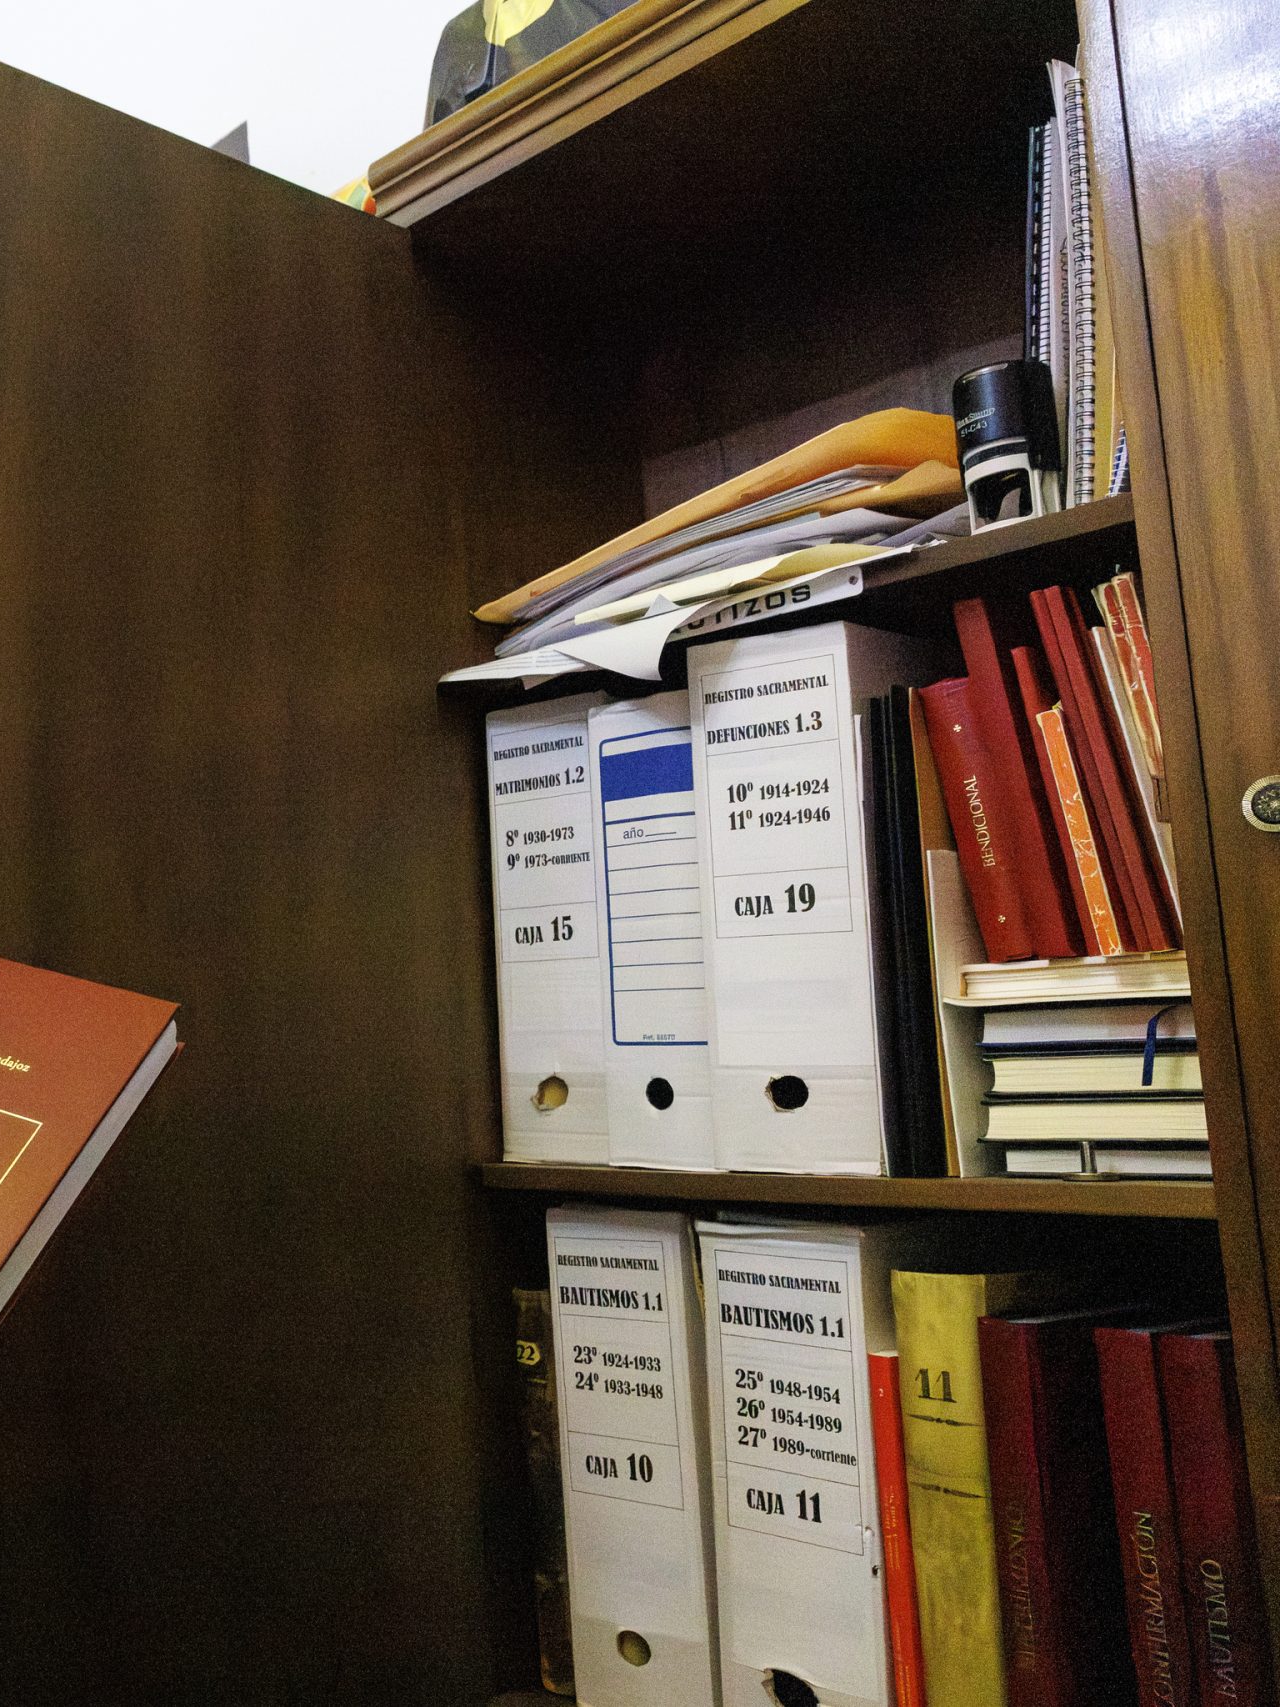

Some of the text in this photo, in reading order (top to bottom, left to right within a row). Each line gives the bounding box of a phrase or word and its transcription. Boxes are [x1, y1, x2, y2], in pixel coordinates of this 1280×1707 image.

[704, 674, 829, 704] REGISTRO SACRAMENTAL
[707, 711, 823, 744] DEFUNCIONES 1.3
[494, 736, 584, 761] REGISTRO SACRAMENTAL
[496, 766, 585, 796] MATRIMONIOS 1.2
[759, 778, 830, 800] 1914-1924
[758, 806, 830, 828] 1924-1946
[964, 775, 996, 867] BENDICIONAL
[523, 826, 574, 846] 1930-1973
[734, 883, 816, 918] CAJA 19
[515, 916, 574, 946] CAJA 15
[557, 1254, 659, 1271] REGISTRO SACRAMENTAL
[718, 1269, 841, 1294] REGISTRO SACRAMENTAL
[560, 1286, 663, 1311] BAUTISMOS 1.1
[721, 1303, 844, 1338] BAUTISMOS 1.1
[517, 1344, 535, 1361] 22
[602, 1352, 661, 1372] 1924-1933
[604, 1378, 664, 1399] 1933-1948
[769, 1378, 841, 1404] 1948-1954
[914, 1368, 957, 1403] 11
[770, 1407, 842, 1434] 1954-1989
[772, 1436, 857, 1467] 1989-corriente
[586, 1453, 653, 1483] CAJA 10
[746, 1488, 823, 1524] CAJA 11
